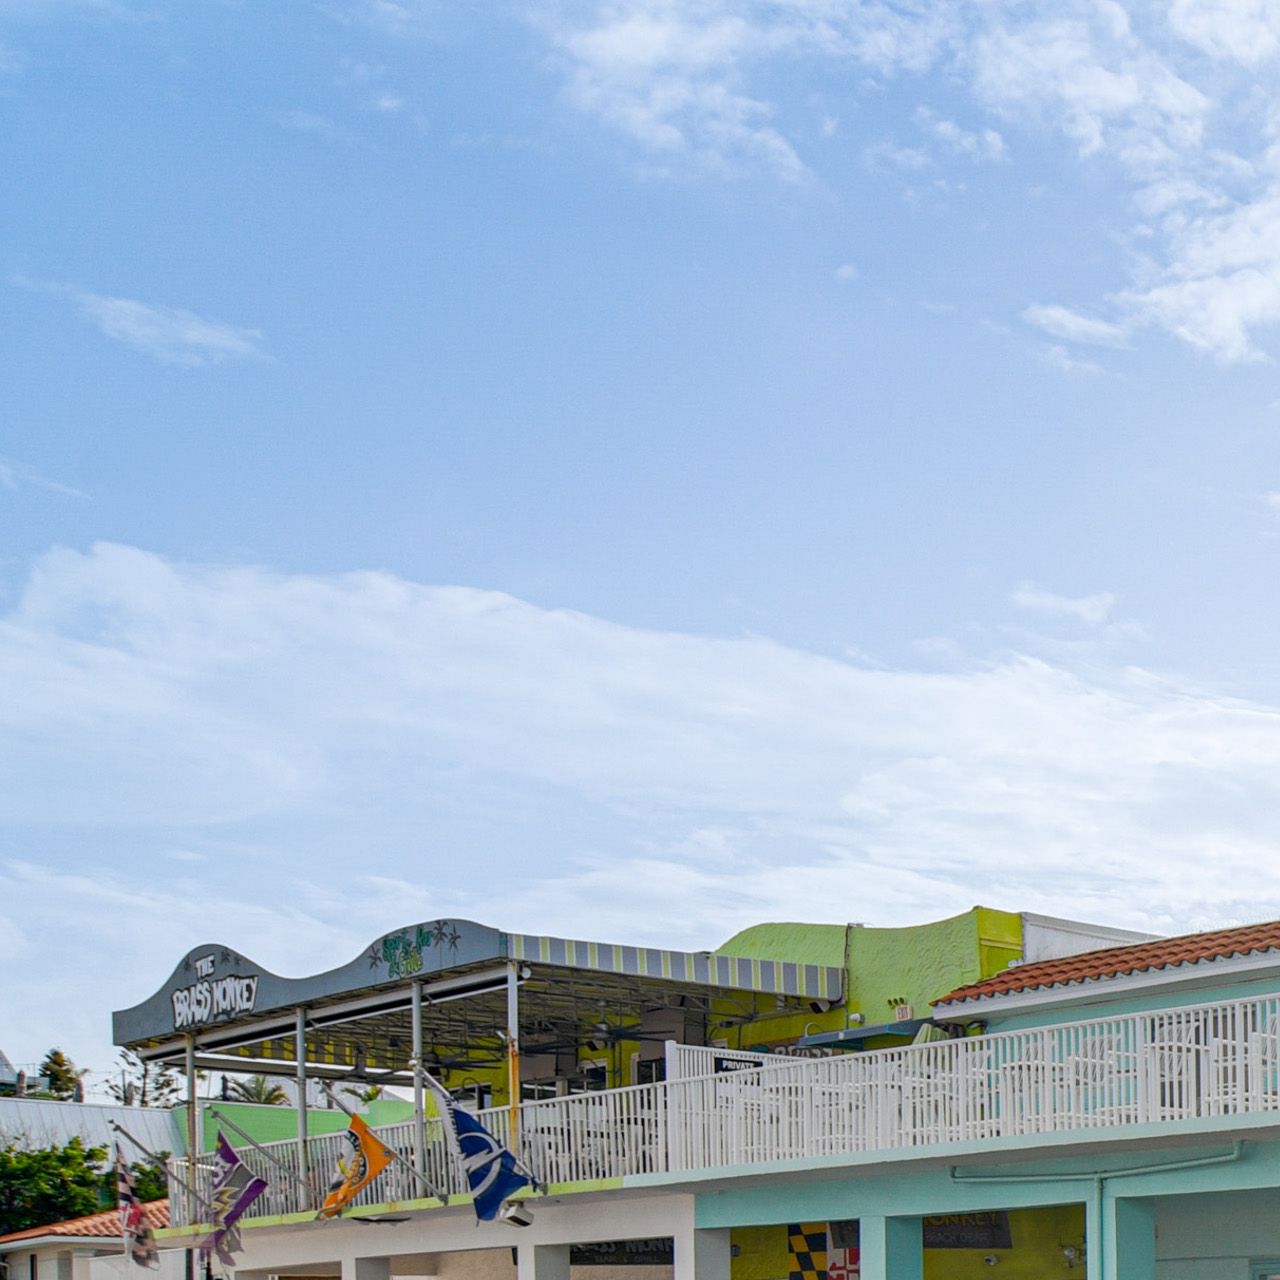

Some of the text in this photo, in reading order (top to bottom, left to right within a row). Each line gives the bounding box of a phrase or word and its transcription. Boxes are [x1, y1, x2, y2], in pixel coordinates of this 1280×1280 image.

[196, 955, 215, 977] THE
[172, 975, 258, 1029] BRASS MONKEY
[722, 1060, 754, 1070] PRIVATE
